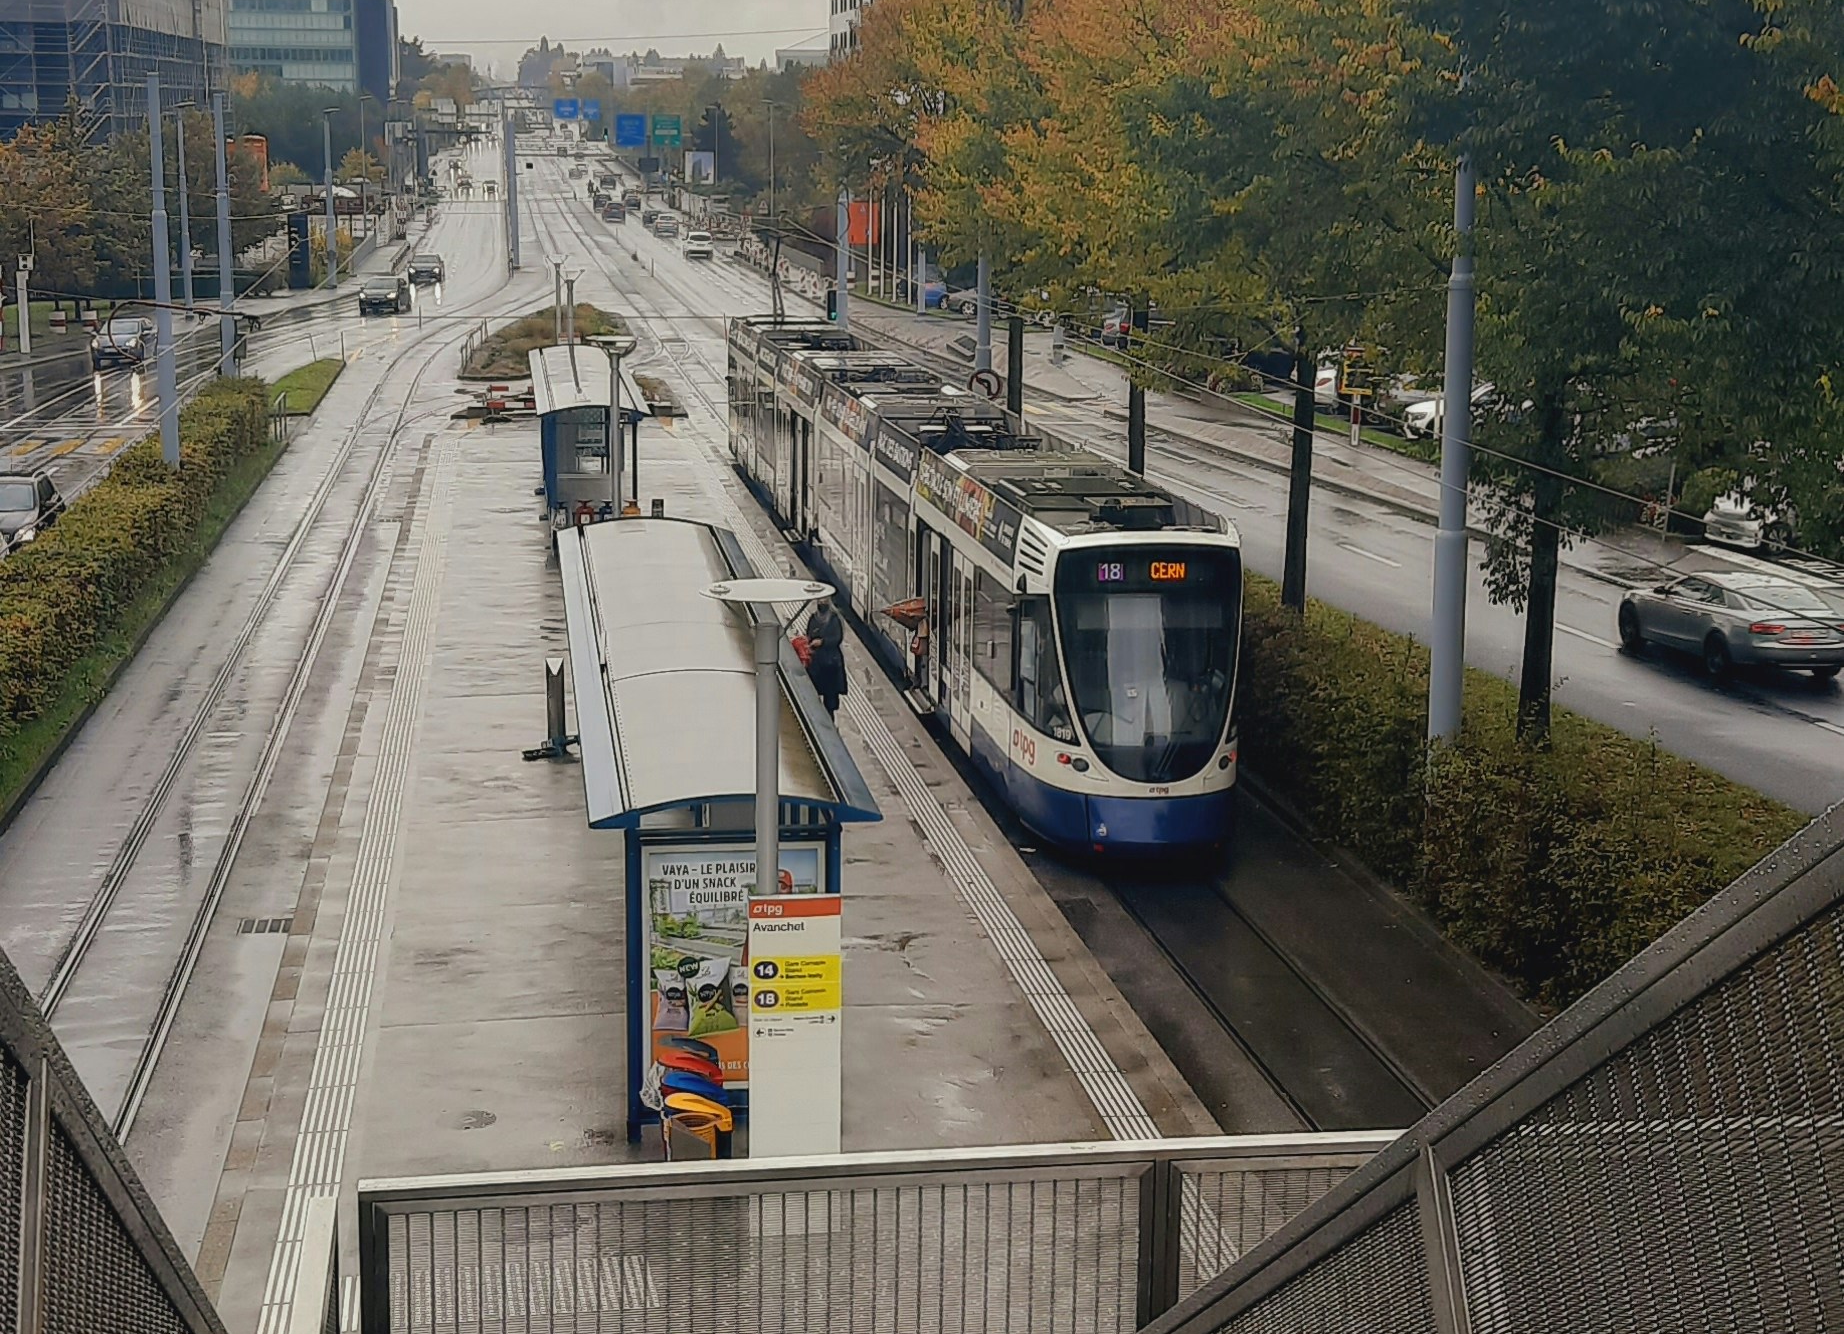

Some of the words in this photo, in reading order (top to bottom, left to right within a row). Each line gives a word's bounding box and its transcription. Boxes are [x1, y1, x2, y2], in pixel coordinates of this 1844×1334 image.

[1101, 563, 1120, 579] 18
[1150, 562, 1185, 578] CERN
[1053, 727, 1072, 740] 1819
[662, 864, 689, 876] VAYA
[701, 863, 713, 875] LE
[716, 862, 756, 874] PLAISIR
[674, 879, 700, 889] D'UN
[702, 877, 736, 889] SNACK
[689, 889, 744, 904] ÉQUILIBRÉ
[753, 921, 805, 932] Avanchet
[678, 962, 699, 973] NEW
[757, 964, 775, 976] 14
[758, 993, 776, 1005] 18
